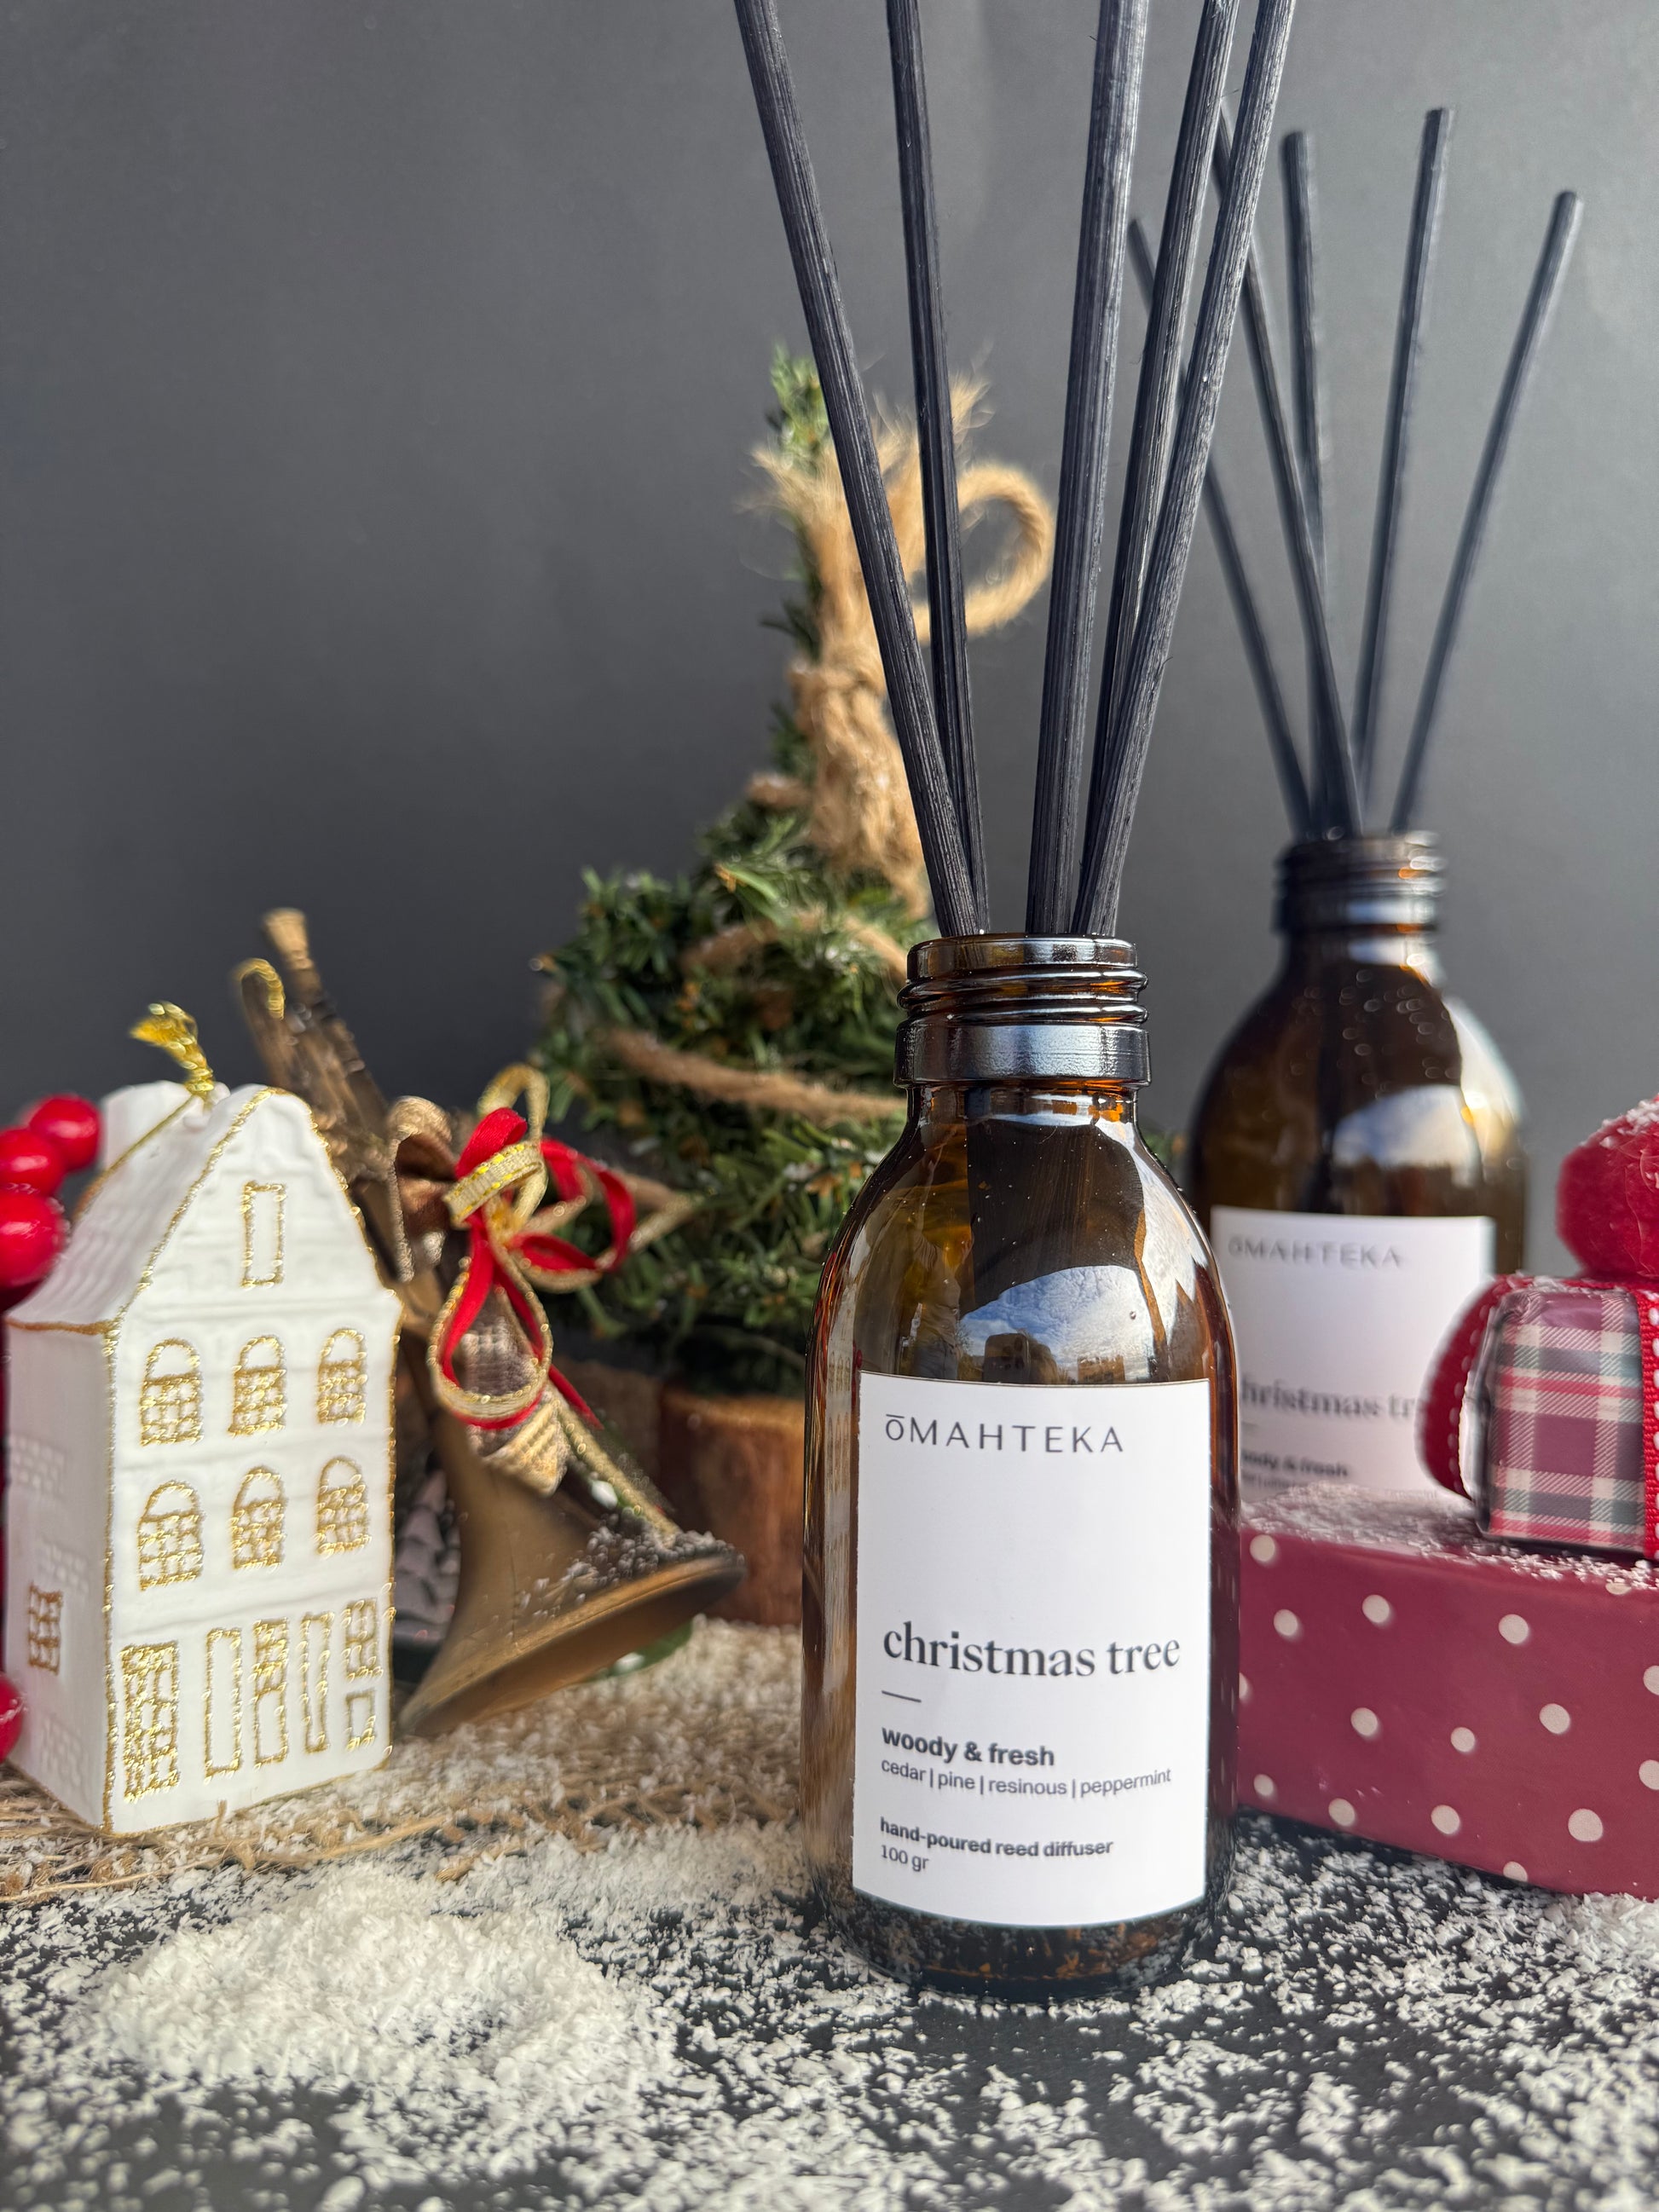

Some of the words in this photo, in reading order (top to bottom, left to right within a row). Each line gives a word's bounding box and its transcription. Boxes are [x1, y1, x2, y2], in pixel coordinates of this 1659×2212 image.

[1241, 1373, 1379, 1417] hristmas
[1388, 1395, 1414, 1418] tr
[883, 1620, 1095, 1678] christmas
[1106, 1639, 1181, 1675] tree
[882, 1727, 958, 1763] woody
[964, 1741, 983, 1763] &
[988, 1742, 1055, 1767] fresh
[881, 1759, 927, 1782] cedar
[938, 1770, 975, 1790] pine
[989, 1777, 1067, 1795] resinous
[1080, 1768, 1171, 1799] peppermint
[880, 1816, 991, 1855] hand-poured
[995, 1839, 1039, 1857] reed
[1043, 1840, 1114, 1857] diffuser
[882, 1844, 909, 1865] 100
[911, 1855, 929, 1873] gr
